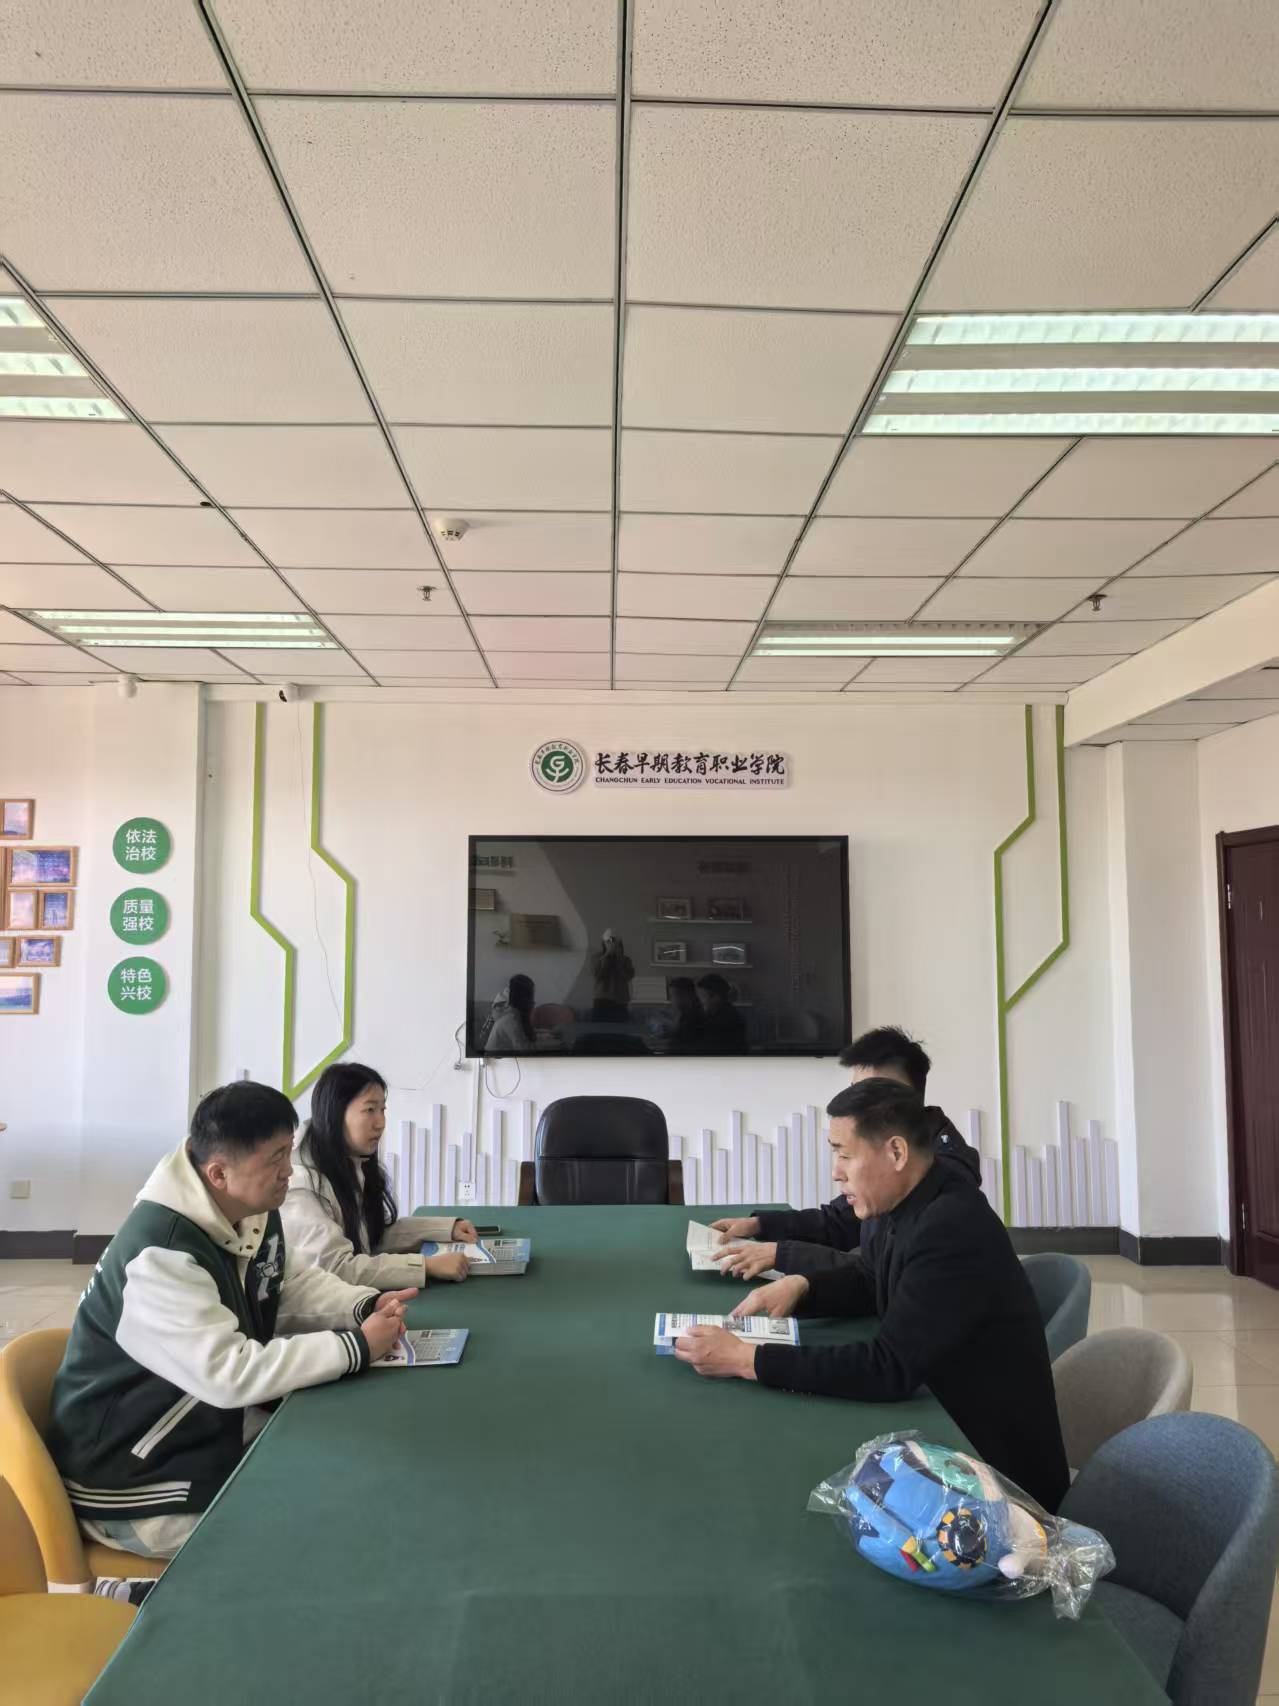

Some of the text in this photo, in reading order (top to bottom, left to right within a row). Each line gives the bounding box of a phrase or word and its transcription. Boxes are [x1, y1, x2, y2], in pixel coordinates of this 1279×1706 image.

[594, 752, 785, 775] 长春早期教育职业学院
[126, 829, 157, 844] 依法
[125, 846, 156, 861] 治校
[123, 899, 154, 914] 质量
[123, 916, 154, 932] 强校
[121, 968, 152, 984] 特色
[121, 986, 152, 1001] 兴校
